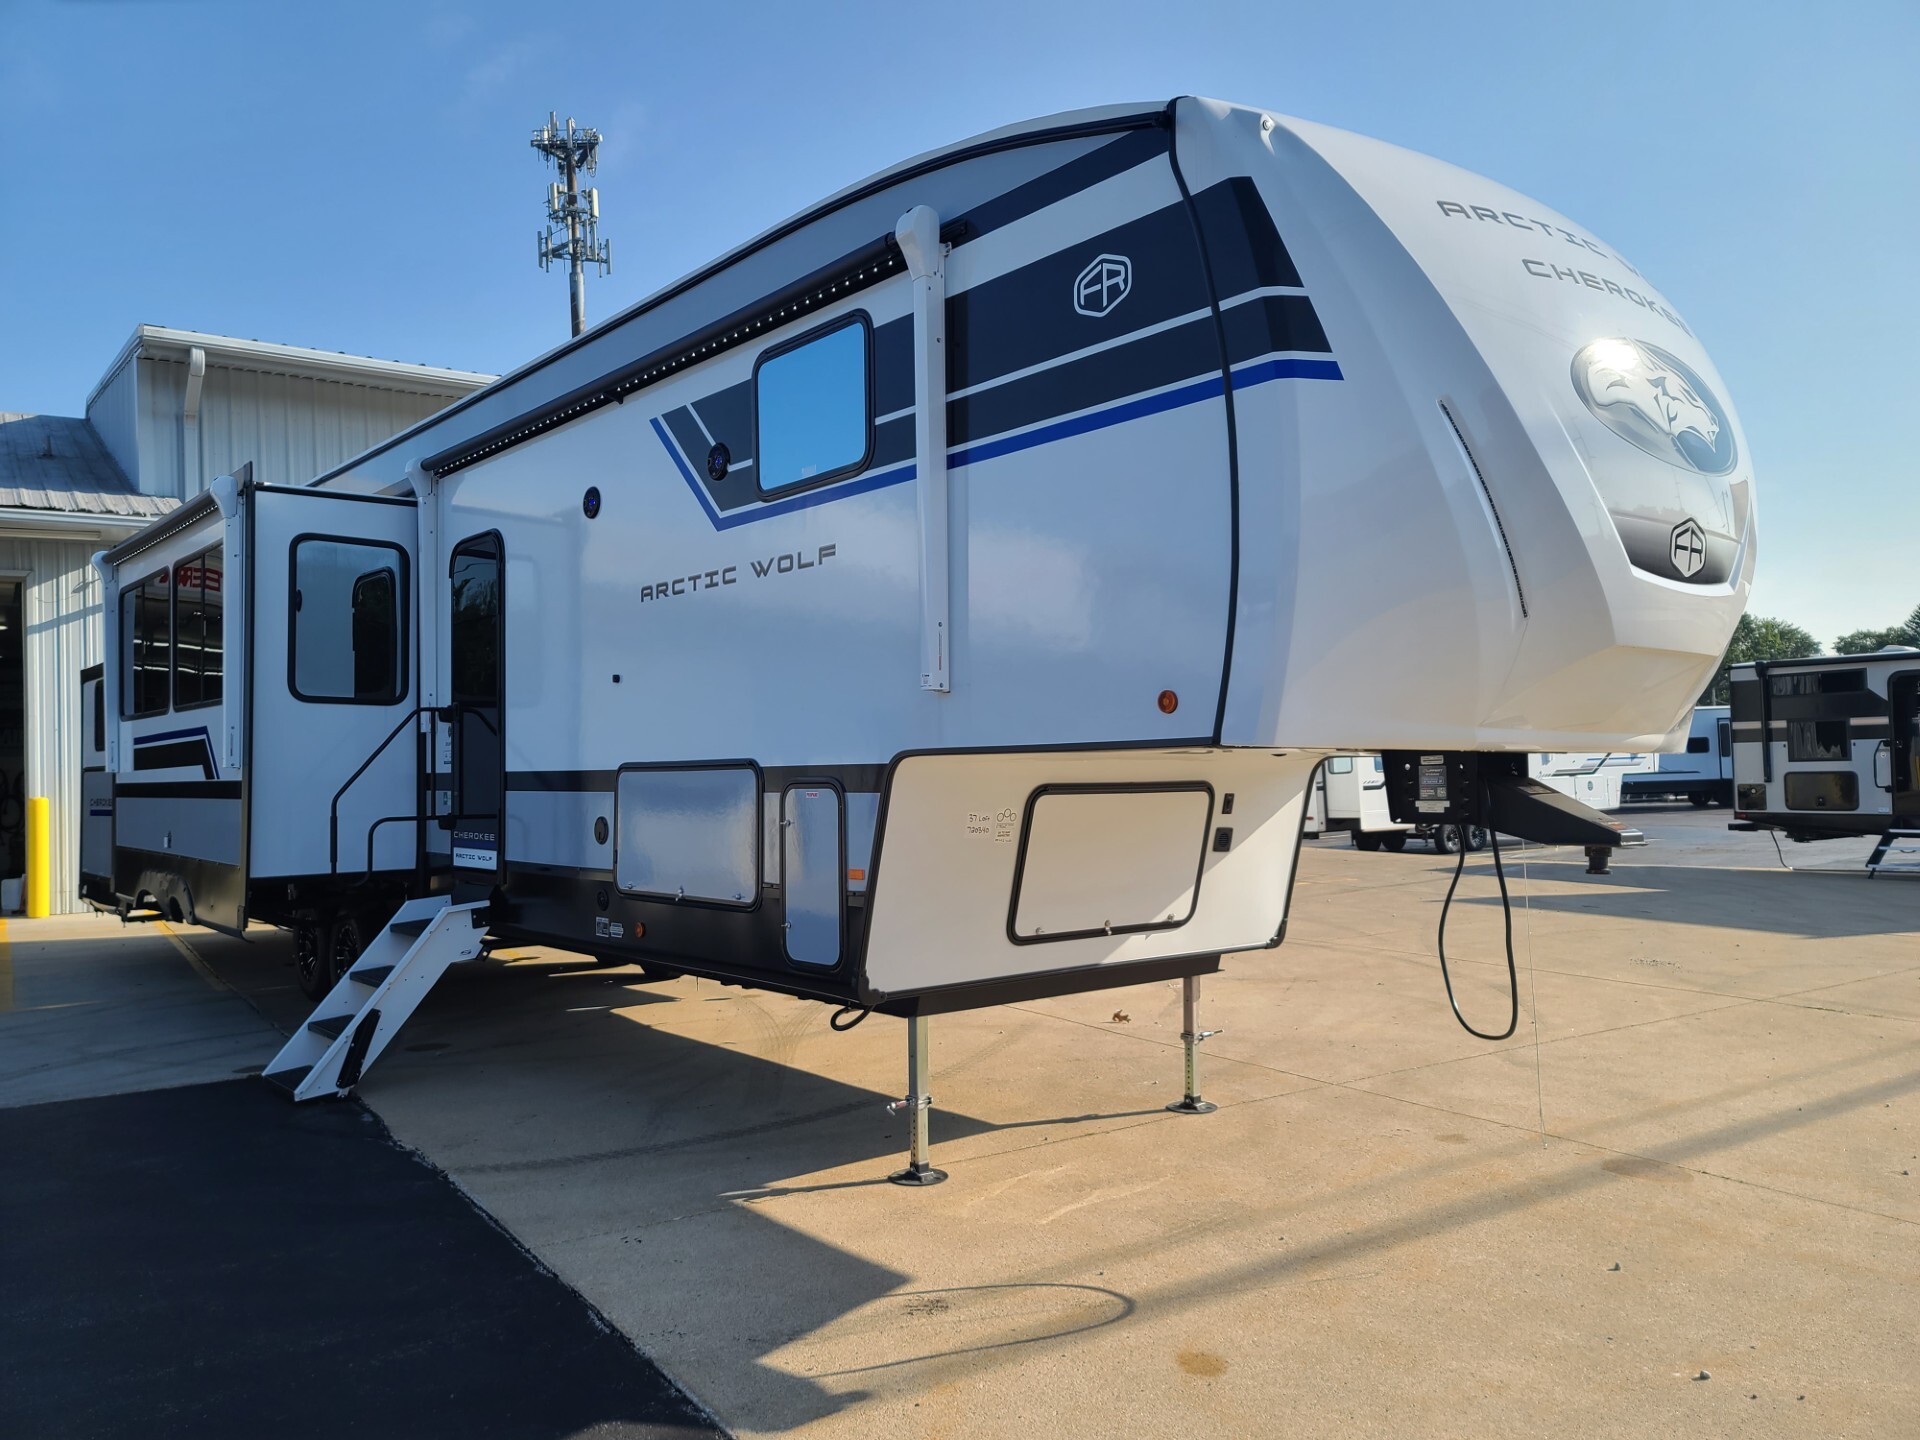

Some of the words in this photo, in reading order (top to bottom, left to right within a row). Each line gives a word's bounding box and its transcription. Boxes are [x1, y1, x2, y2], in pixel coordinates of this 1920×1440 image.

[1436, 199, 1609, 259] ARCTIC
[1521, 257, 1694, 338] CHEROKEE
[640, 565, 737, 603] ARCTIC
[749, 543, 837, 579] WOLF
[453, 831, 496, 841] CHEROKEE
[455, 852, 476, 861] ARCTIC
[477, 854, 493, 862] WOLF
